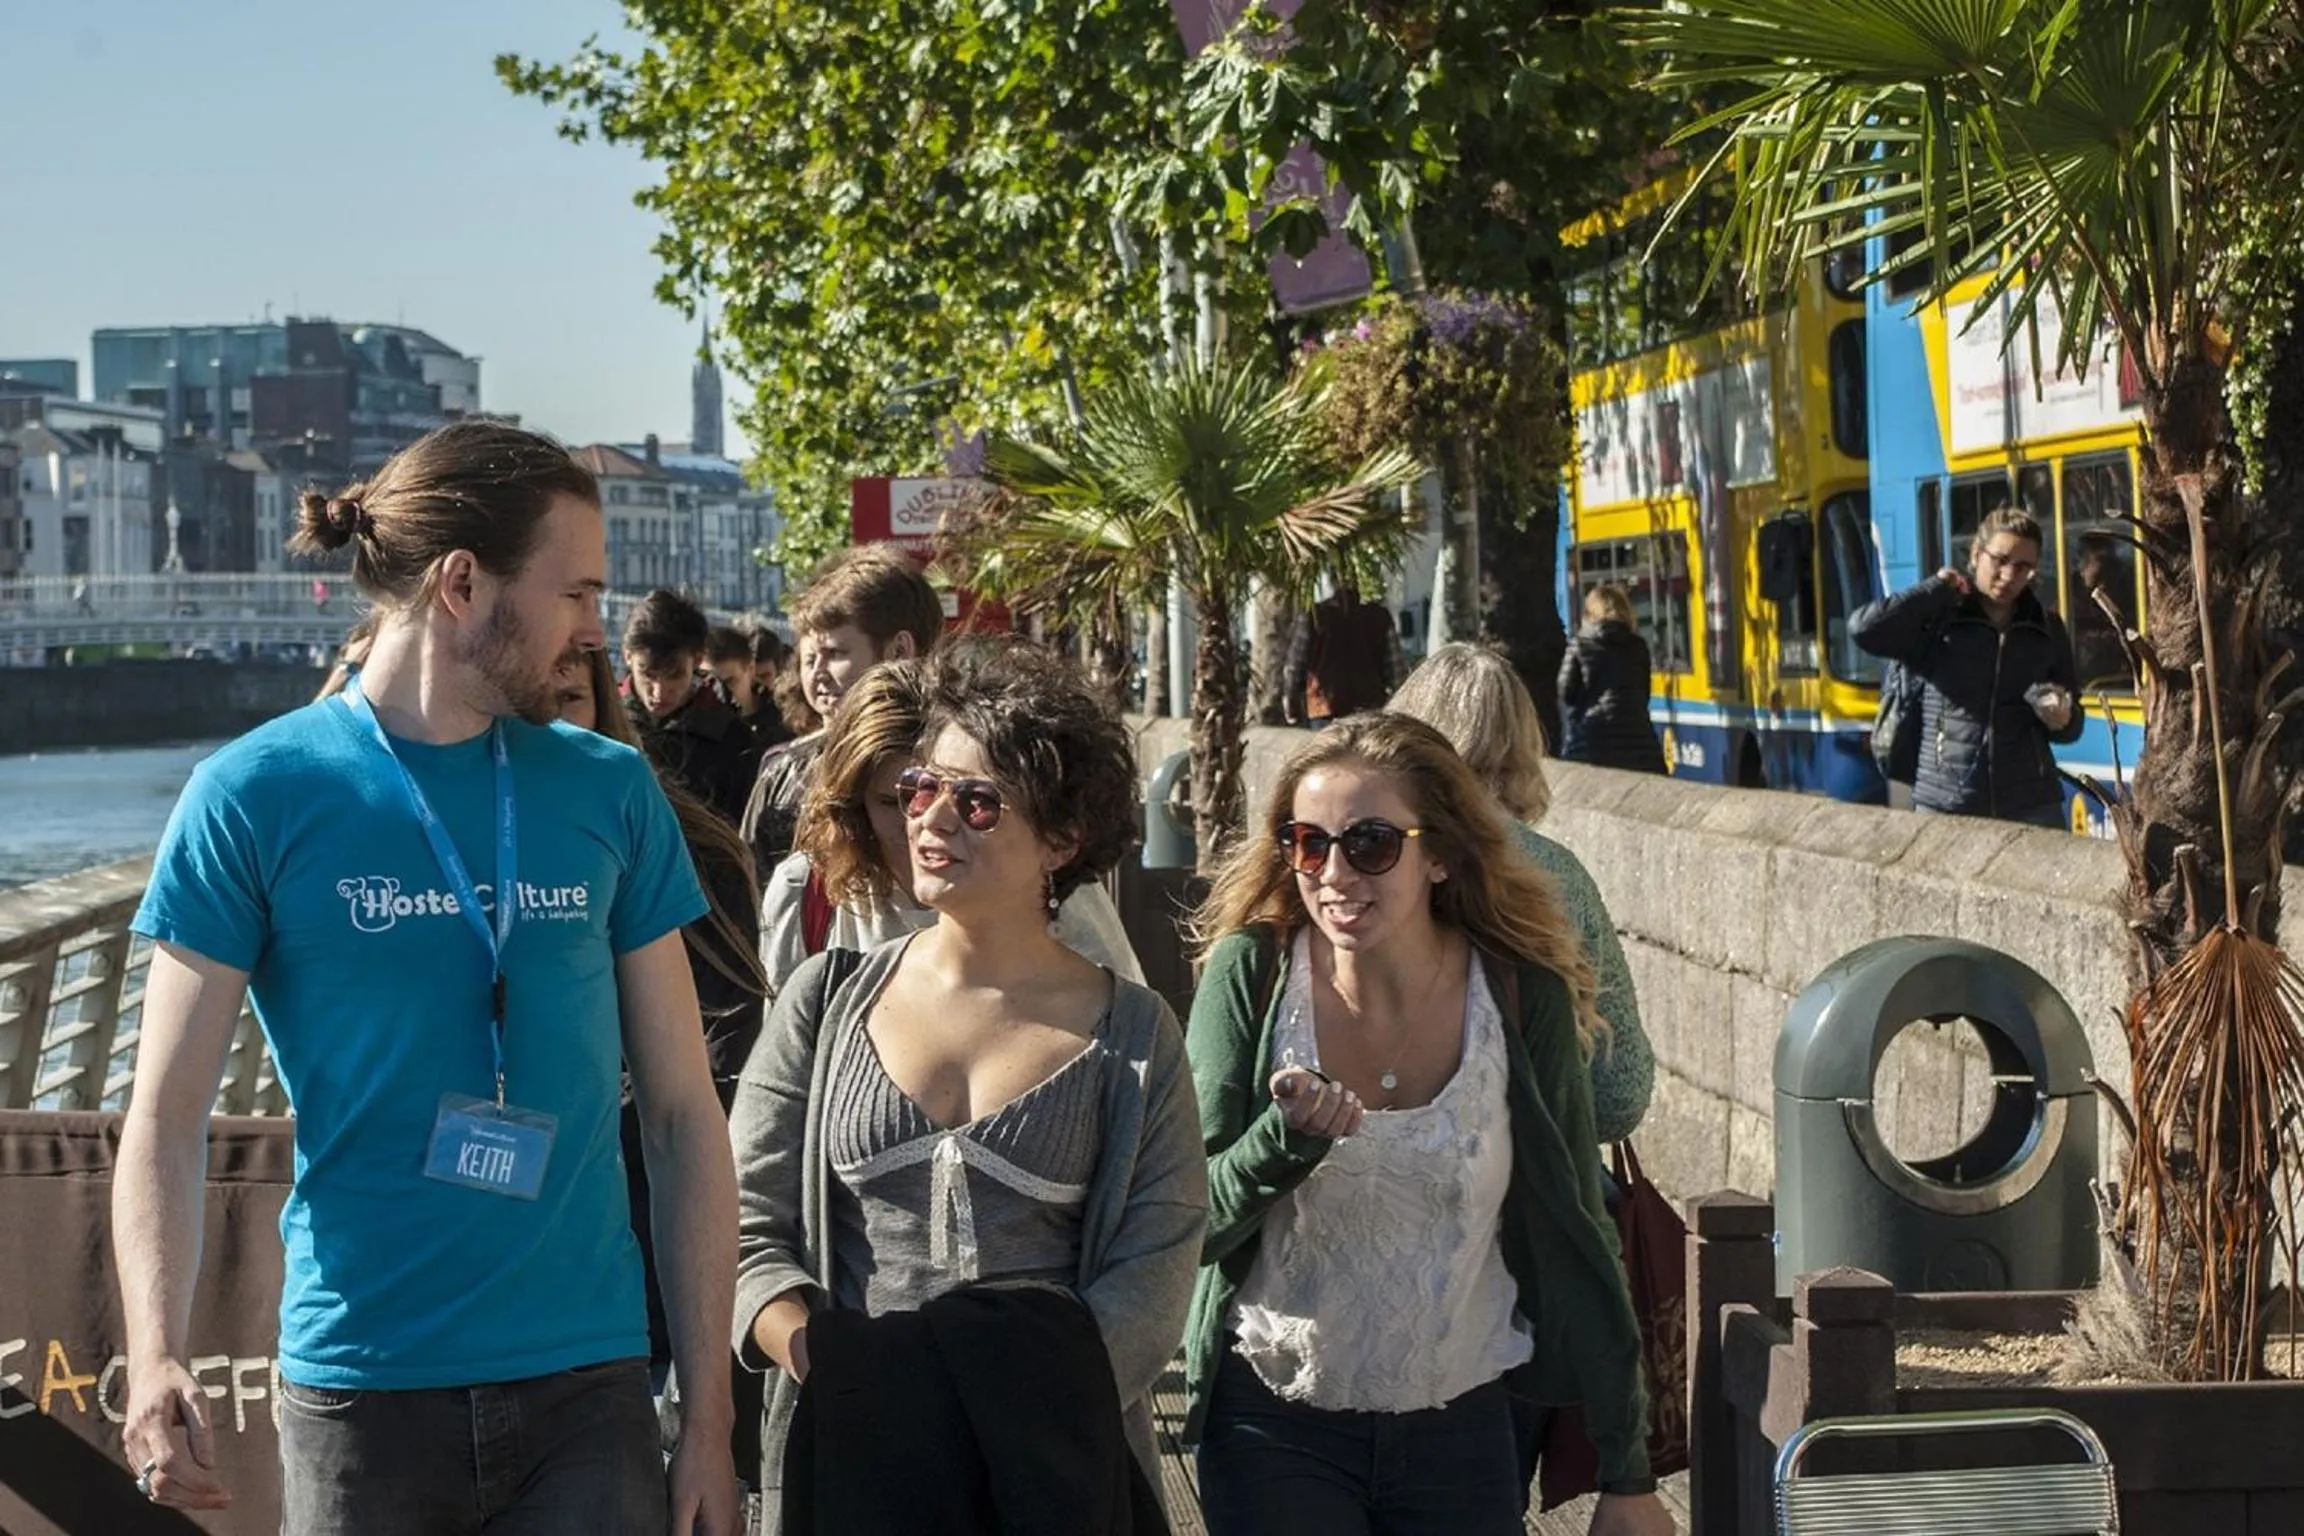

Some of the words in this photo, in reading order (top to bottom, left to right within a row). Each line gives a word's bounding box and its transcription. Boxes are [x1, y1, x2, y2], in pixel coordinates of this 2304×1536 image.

[363, 888, 462, 919] Hoste
[474, 881, 588, 911] Clture
[456, 1142, 515, 1184] KEITH
